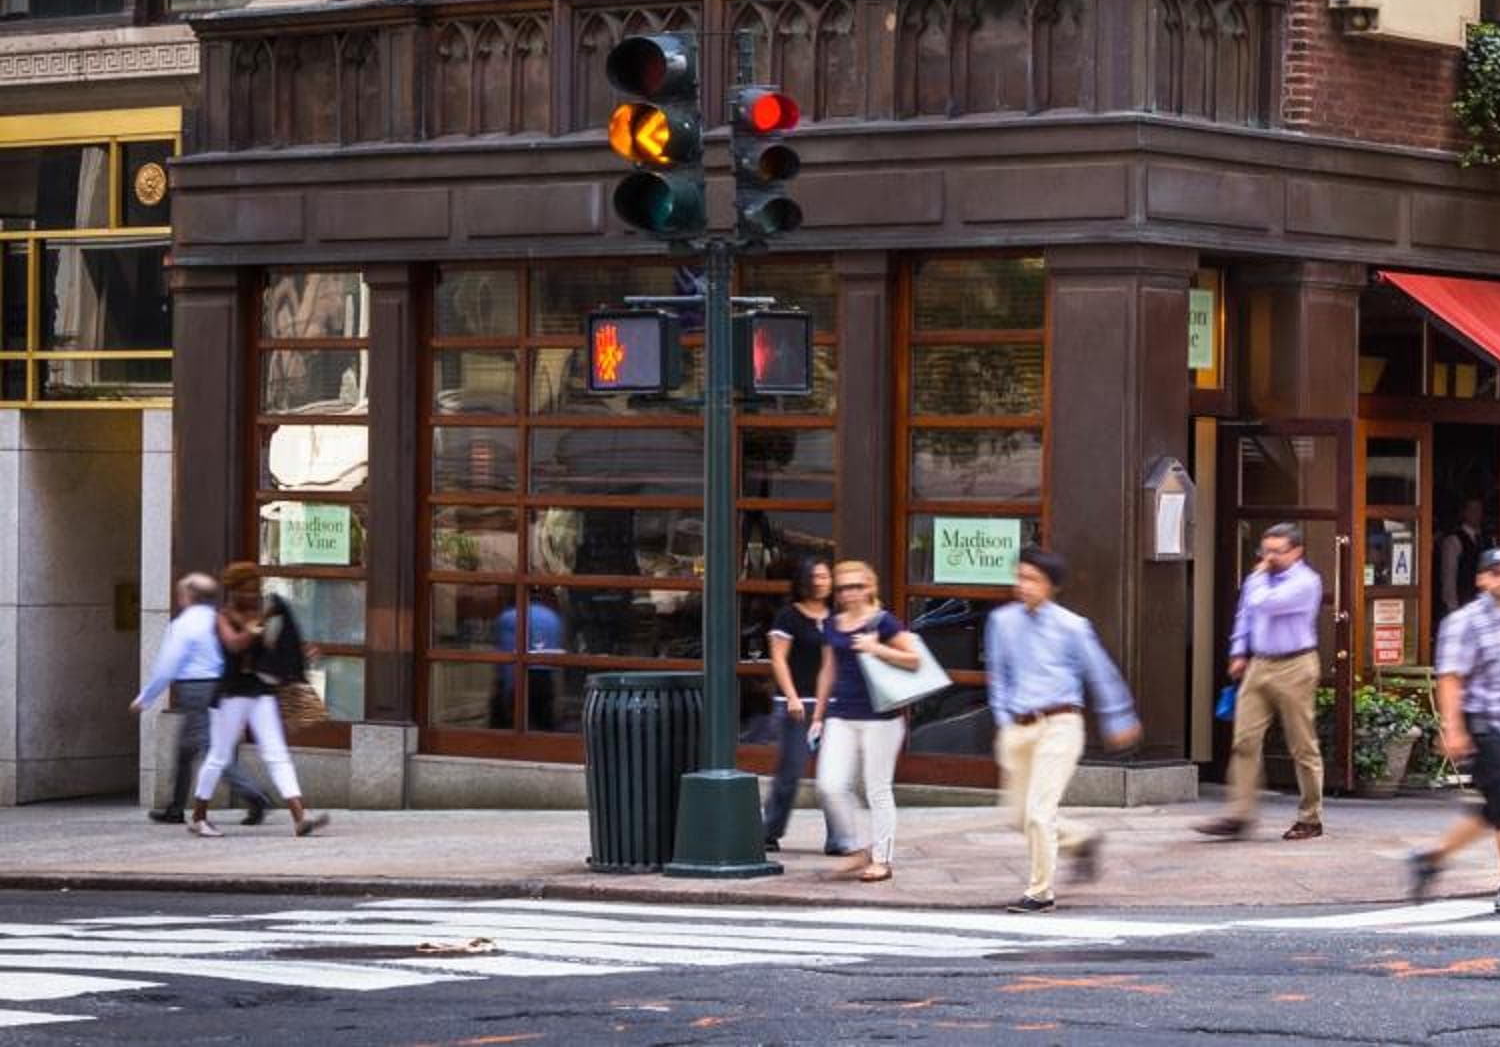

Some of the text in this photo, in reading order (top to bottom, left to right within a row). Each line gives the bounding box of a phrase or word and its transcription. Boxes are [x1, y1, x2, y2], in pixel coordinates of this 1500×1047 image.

[288, 516, 344, 533] Madison
[305, 533, 337, 550] Vine
[942, 528, 1013, 548] Madison
[965, 548, 1004, 567] Vine
[1395, 550, 1409, 575] A
